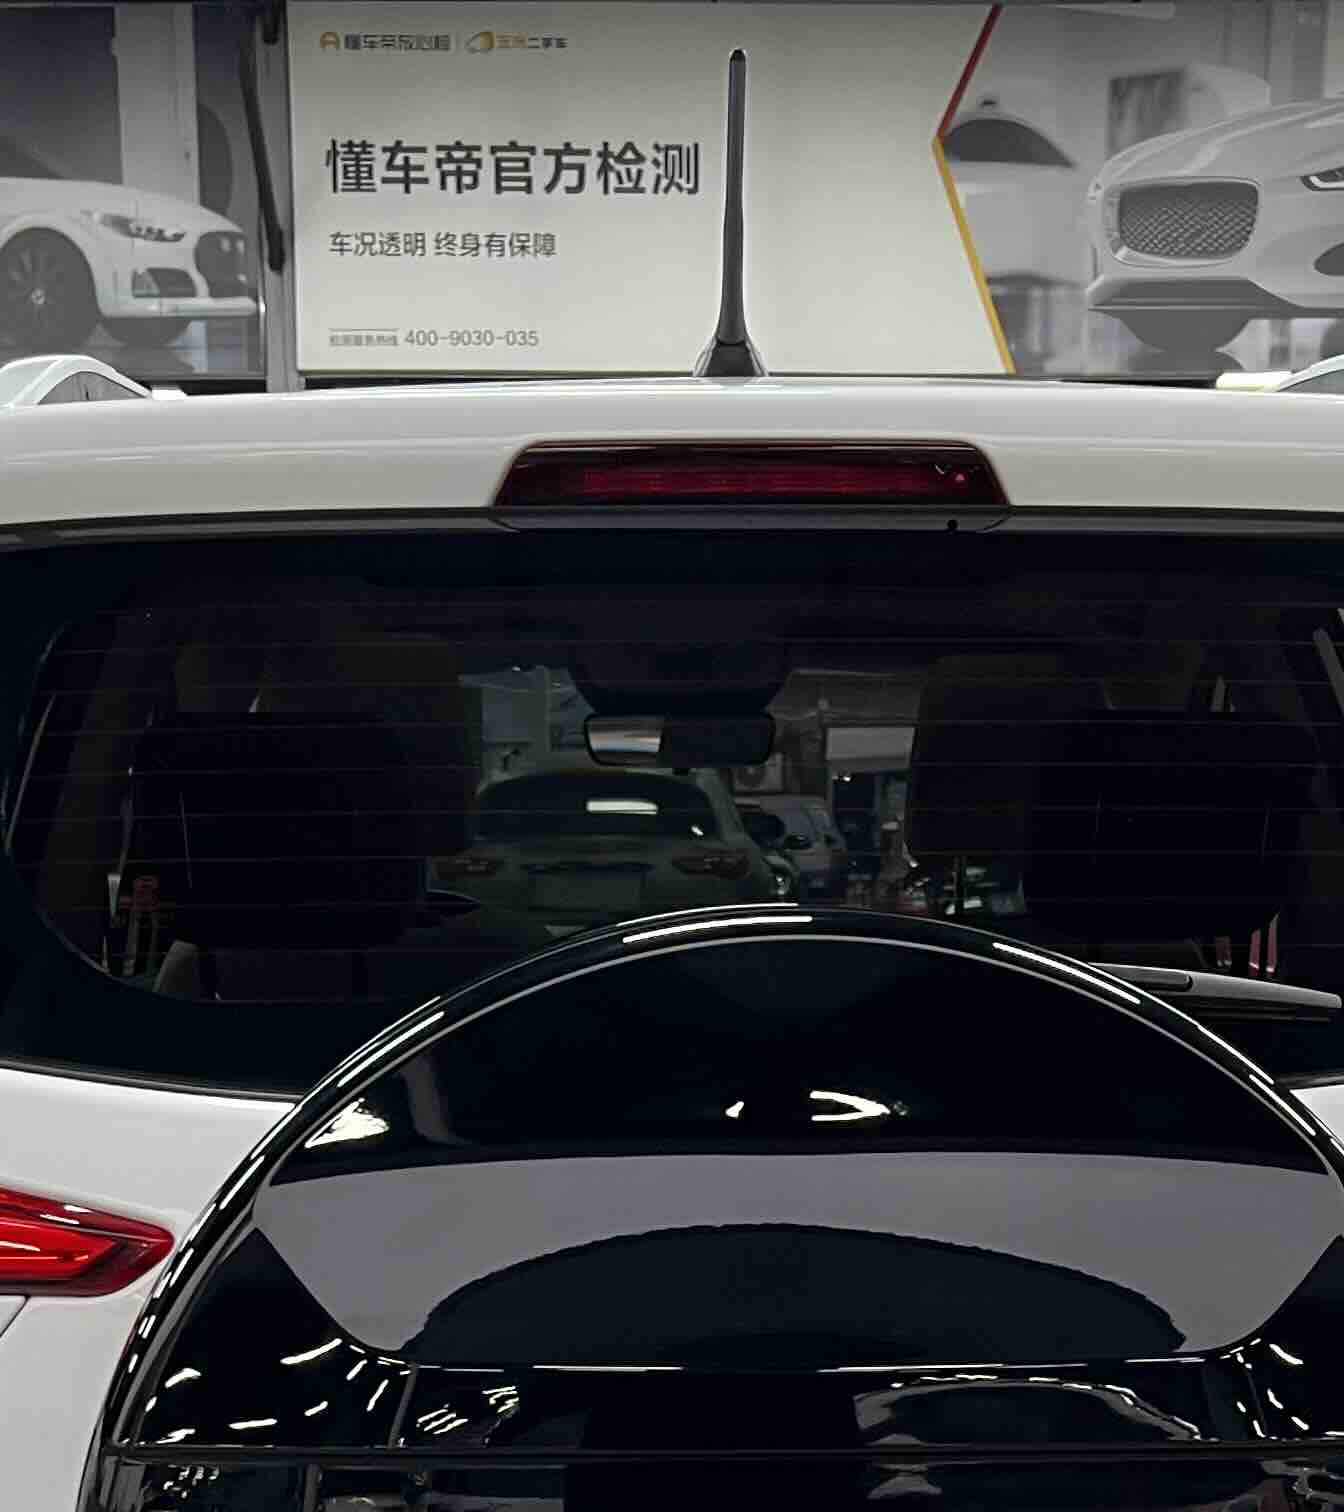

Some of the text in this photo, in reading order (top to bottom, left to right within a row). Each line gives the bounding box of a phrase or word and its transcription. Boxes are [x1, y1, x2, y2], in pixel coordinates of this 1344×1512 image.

[325, 138, 701, 196] 懂车帝官方检测
[328, 231, 558, 257] 车况透明 终身有保障
[405, 328, 540, 347] 400-9030-035
